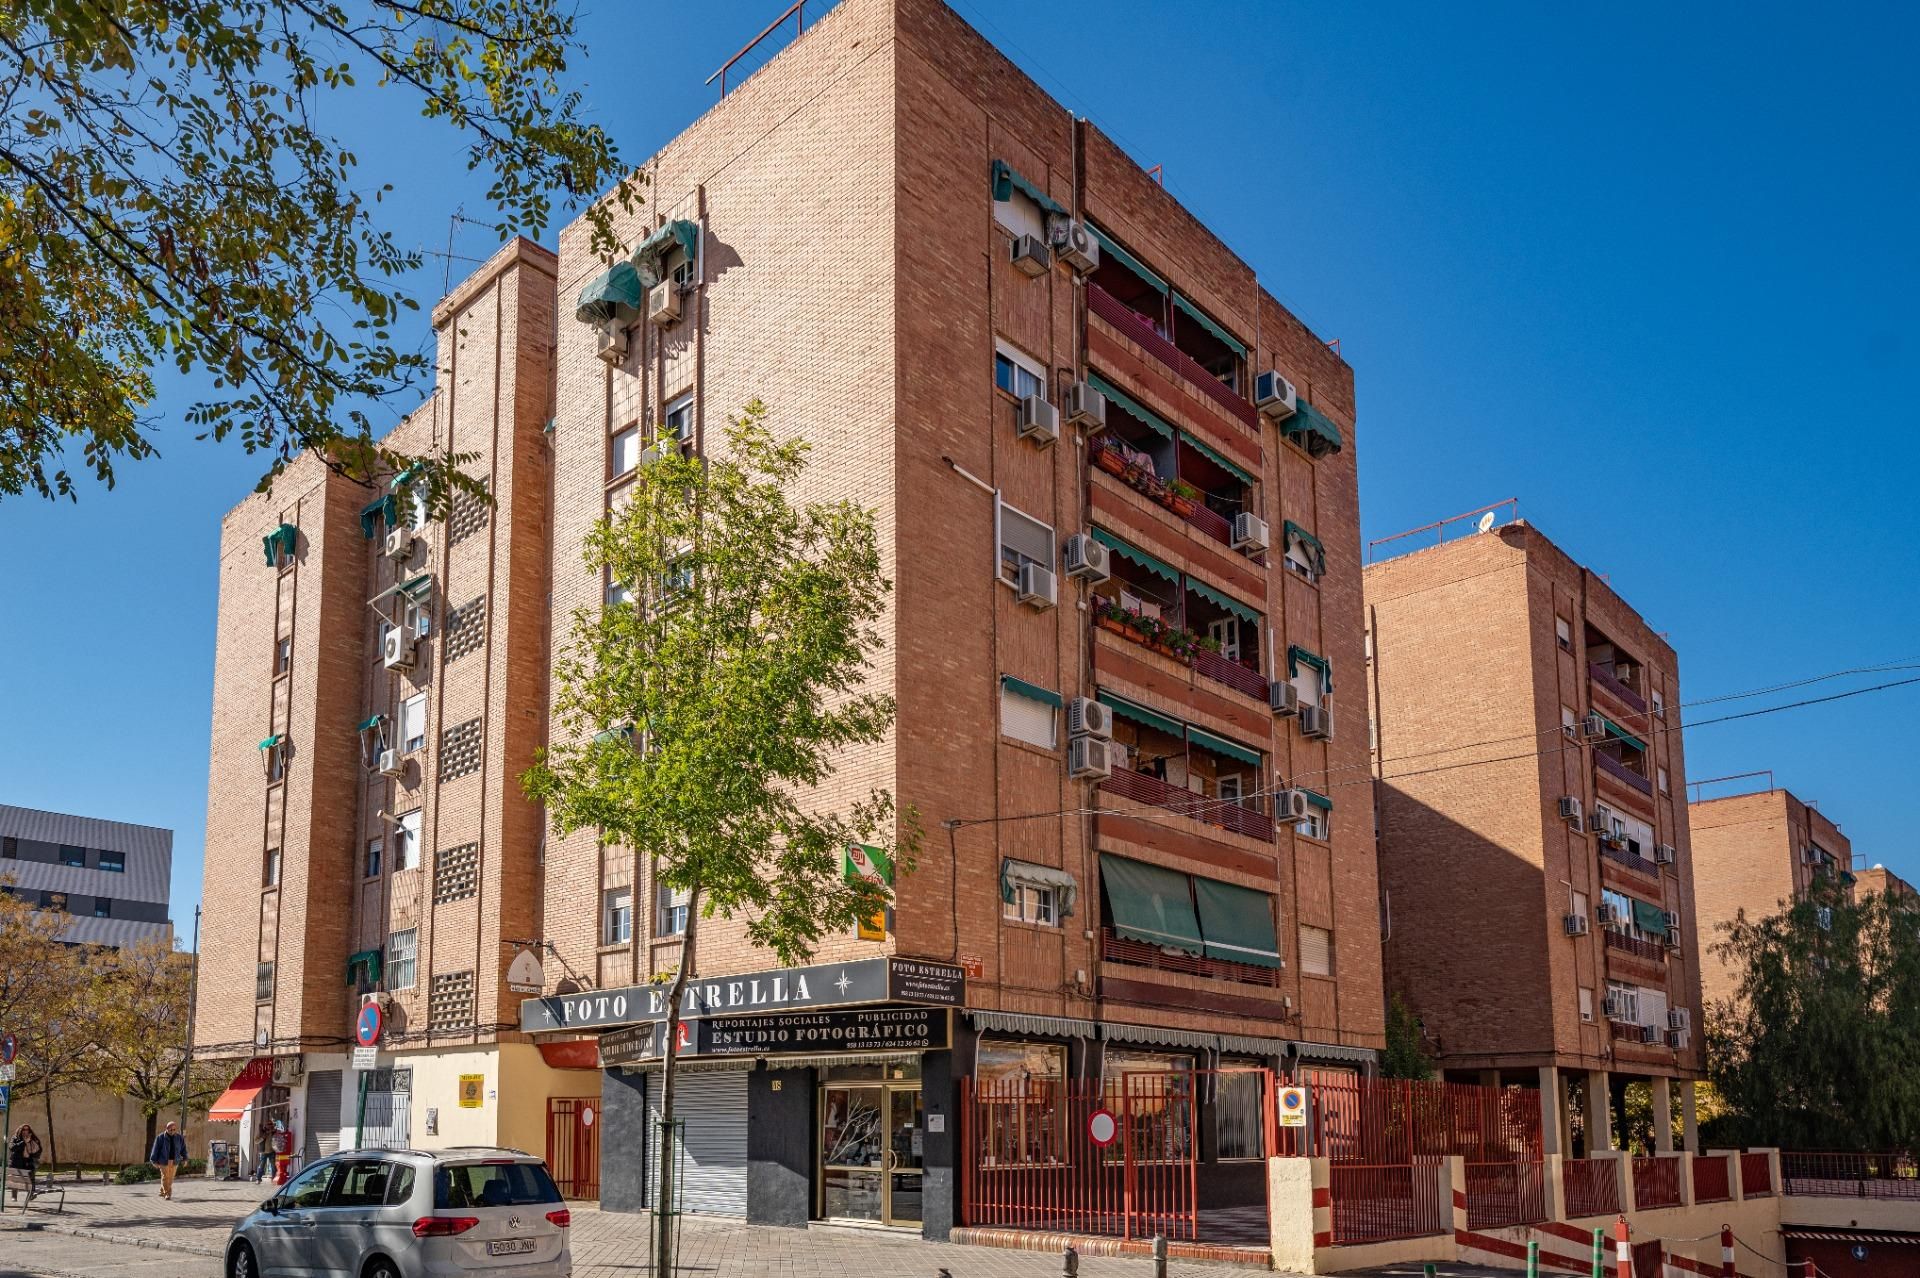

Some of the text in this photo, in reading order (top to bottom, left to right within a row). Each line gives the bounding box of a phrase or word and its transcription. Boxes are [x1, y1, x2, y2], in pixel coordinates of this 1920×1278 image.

[892, 962, 916, 974] FOTO
[919, 965, 963, 979] ESTRELLA
[562, 974, 812, 1022] FOTO ETRELLA
[712, 1018, 774, 1030] REPORTAJES
[779, 1016, 831, 1026] SOCIALES
[858, 1011, 928, 1022] PUBLICIDAD
[711, 1023, 928, 1044] ESTUDIO FOTOGRÁFICO
[493, 1240, 535, 1253] 5030 JNH
